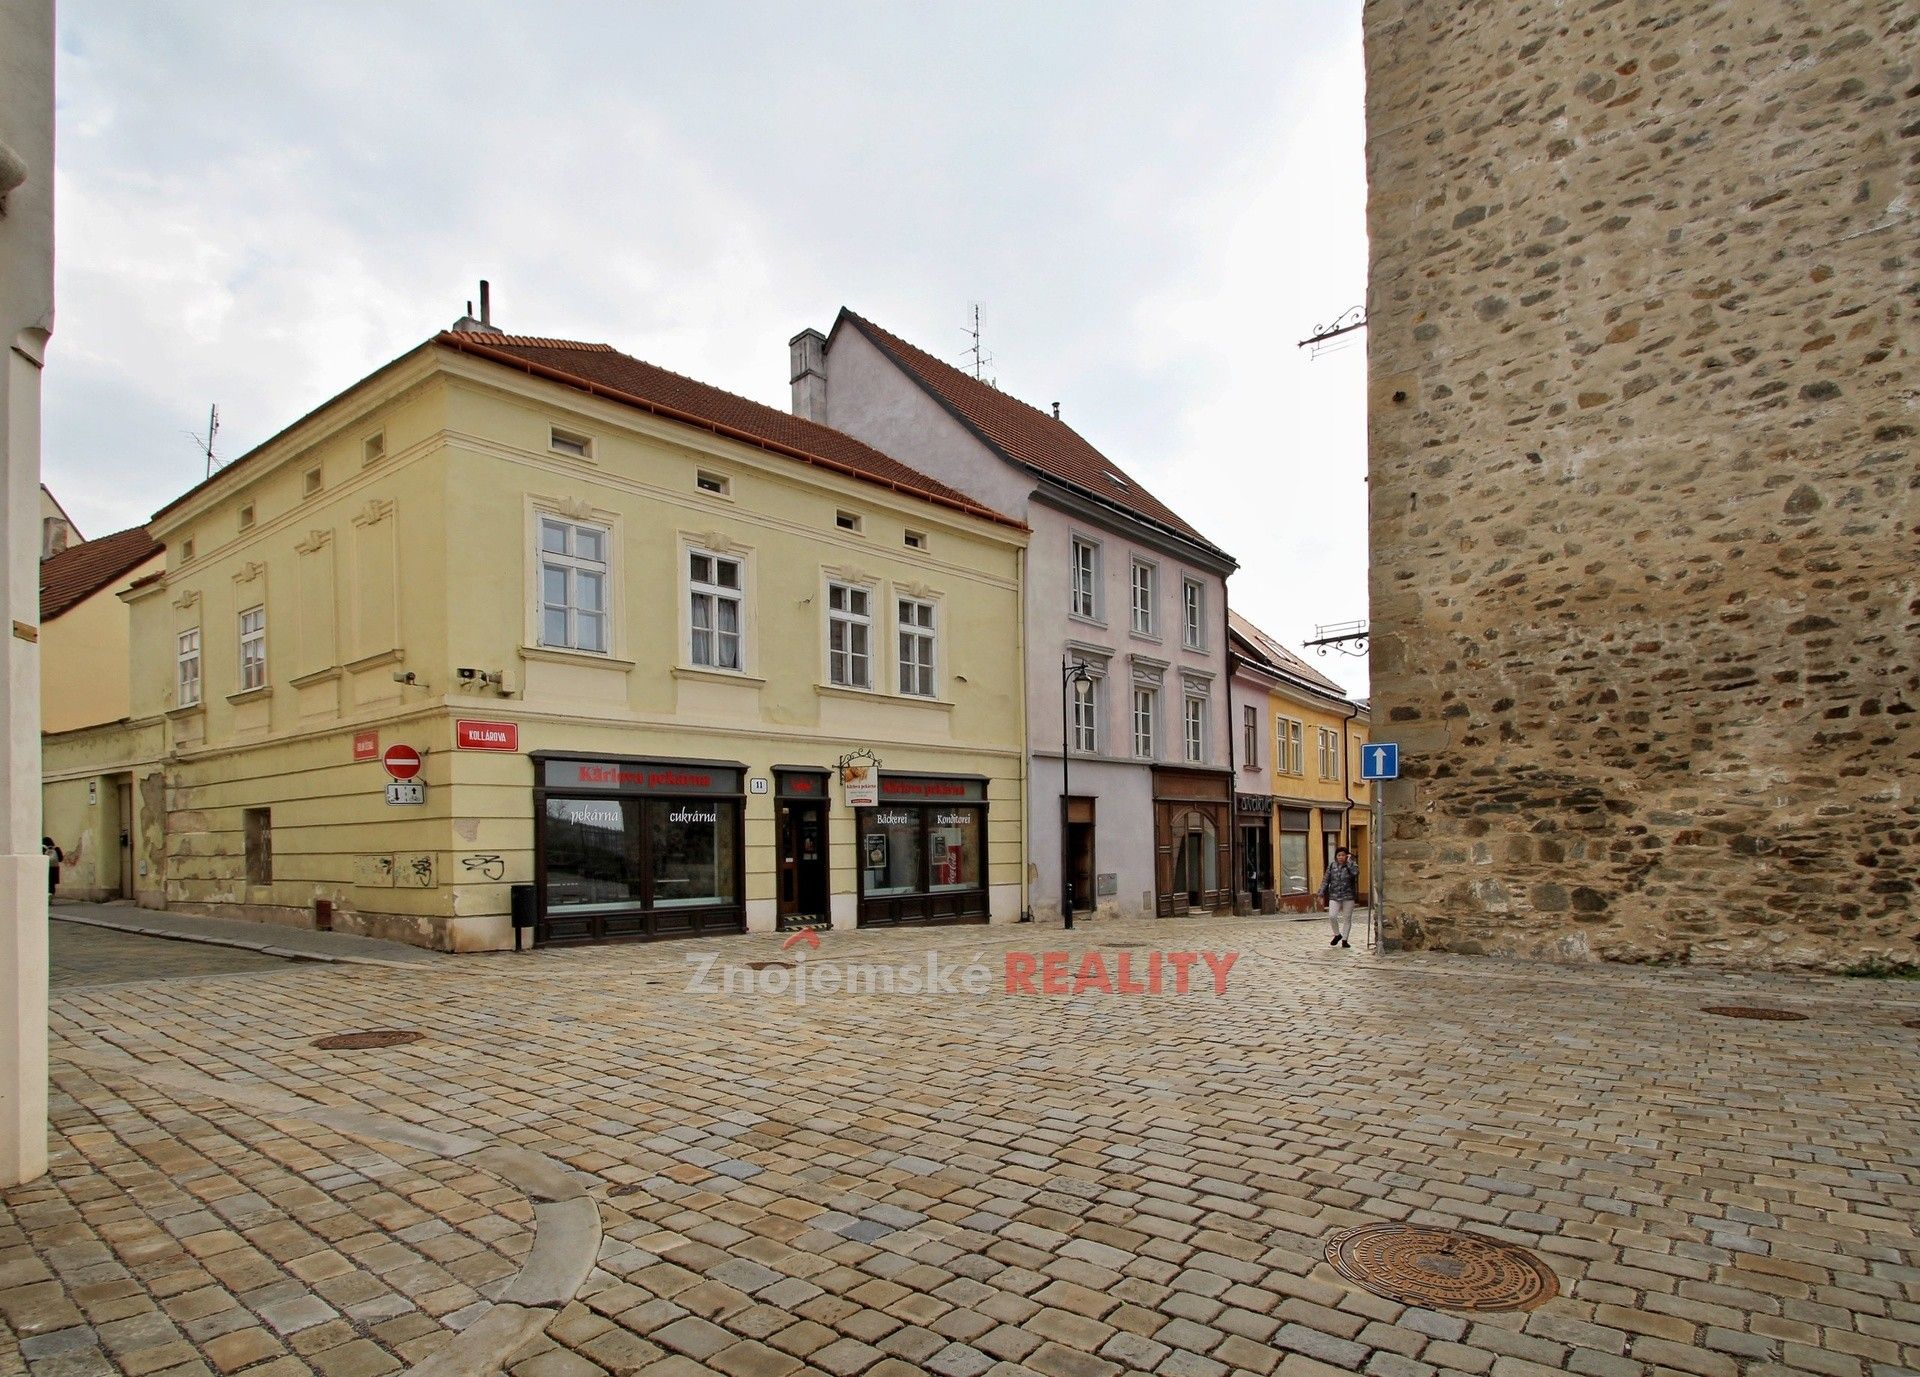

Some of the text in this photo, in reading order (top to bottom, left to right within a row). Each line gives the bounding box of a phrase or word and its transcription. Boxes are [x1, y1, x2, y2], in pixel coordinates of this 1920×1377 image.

[468, 729, 507, 742] KOLLÁROVA
[756, 781, 763, 789] 11
[571, 804, 618, 826] pekárna
[670, 806, 716, 823] cukrárna
[877, 811, 908, 824] Bäckerei
[937, 813, 971, 825] Konditorei
